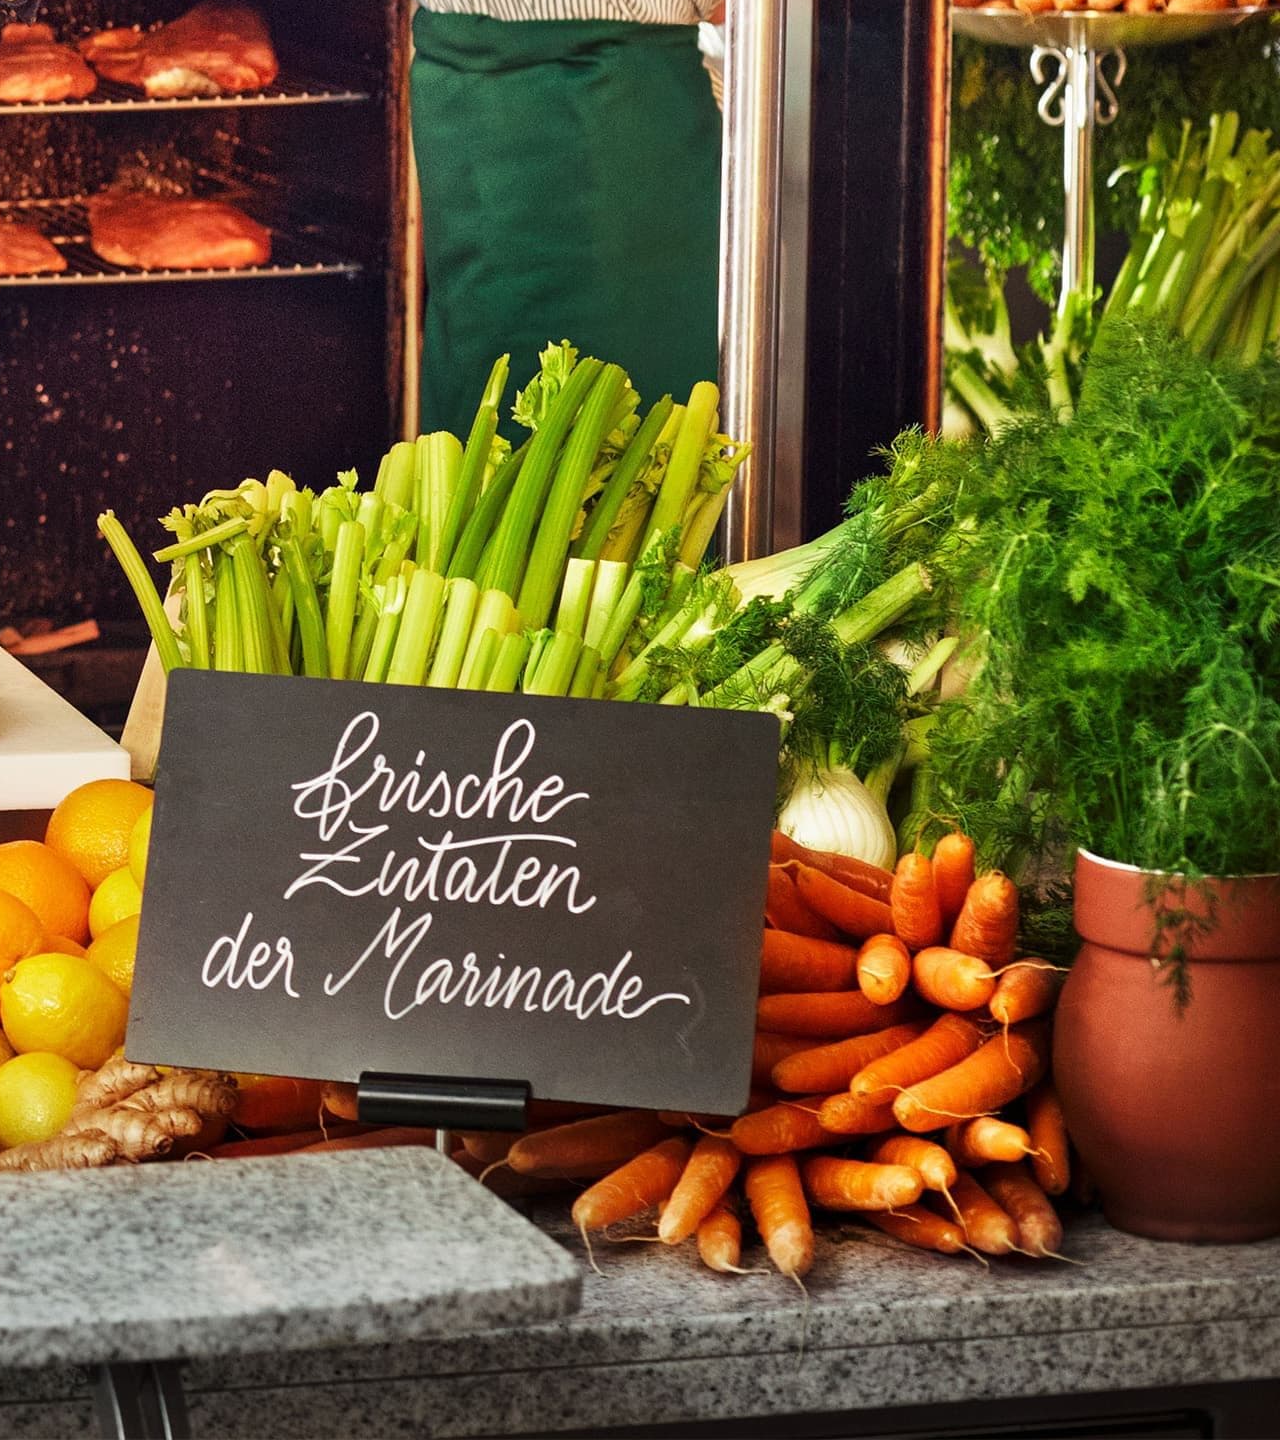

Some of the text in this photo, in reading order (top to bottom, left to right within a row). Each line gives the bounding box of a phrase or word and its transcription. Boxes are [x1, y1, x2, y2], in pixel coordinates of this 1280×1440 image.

[290, 710, 589, 842] frische
[283, 821, 597, 914] Zutaten
[201, 906, 691, 1021] der Marinade
